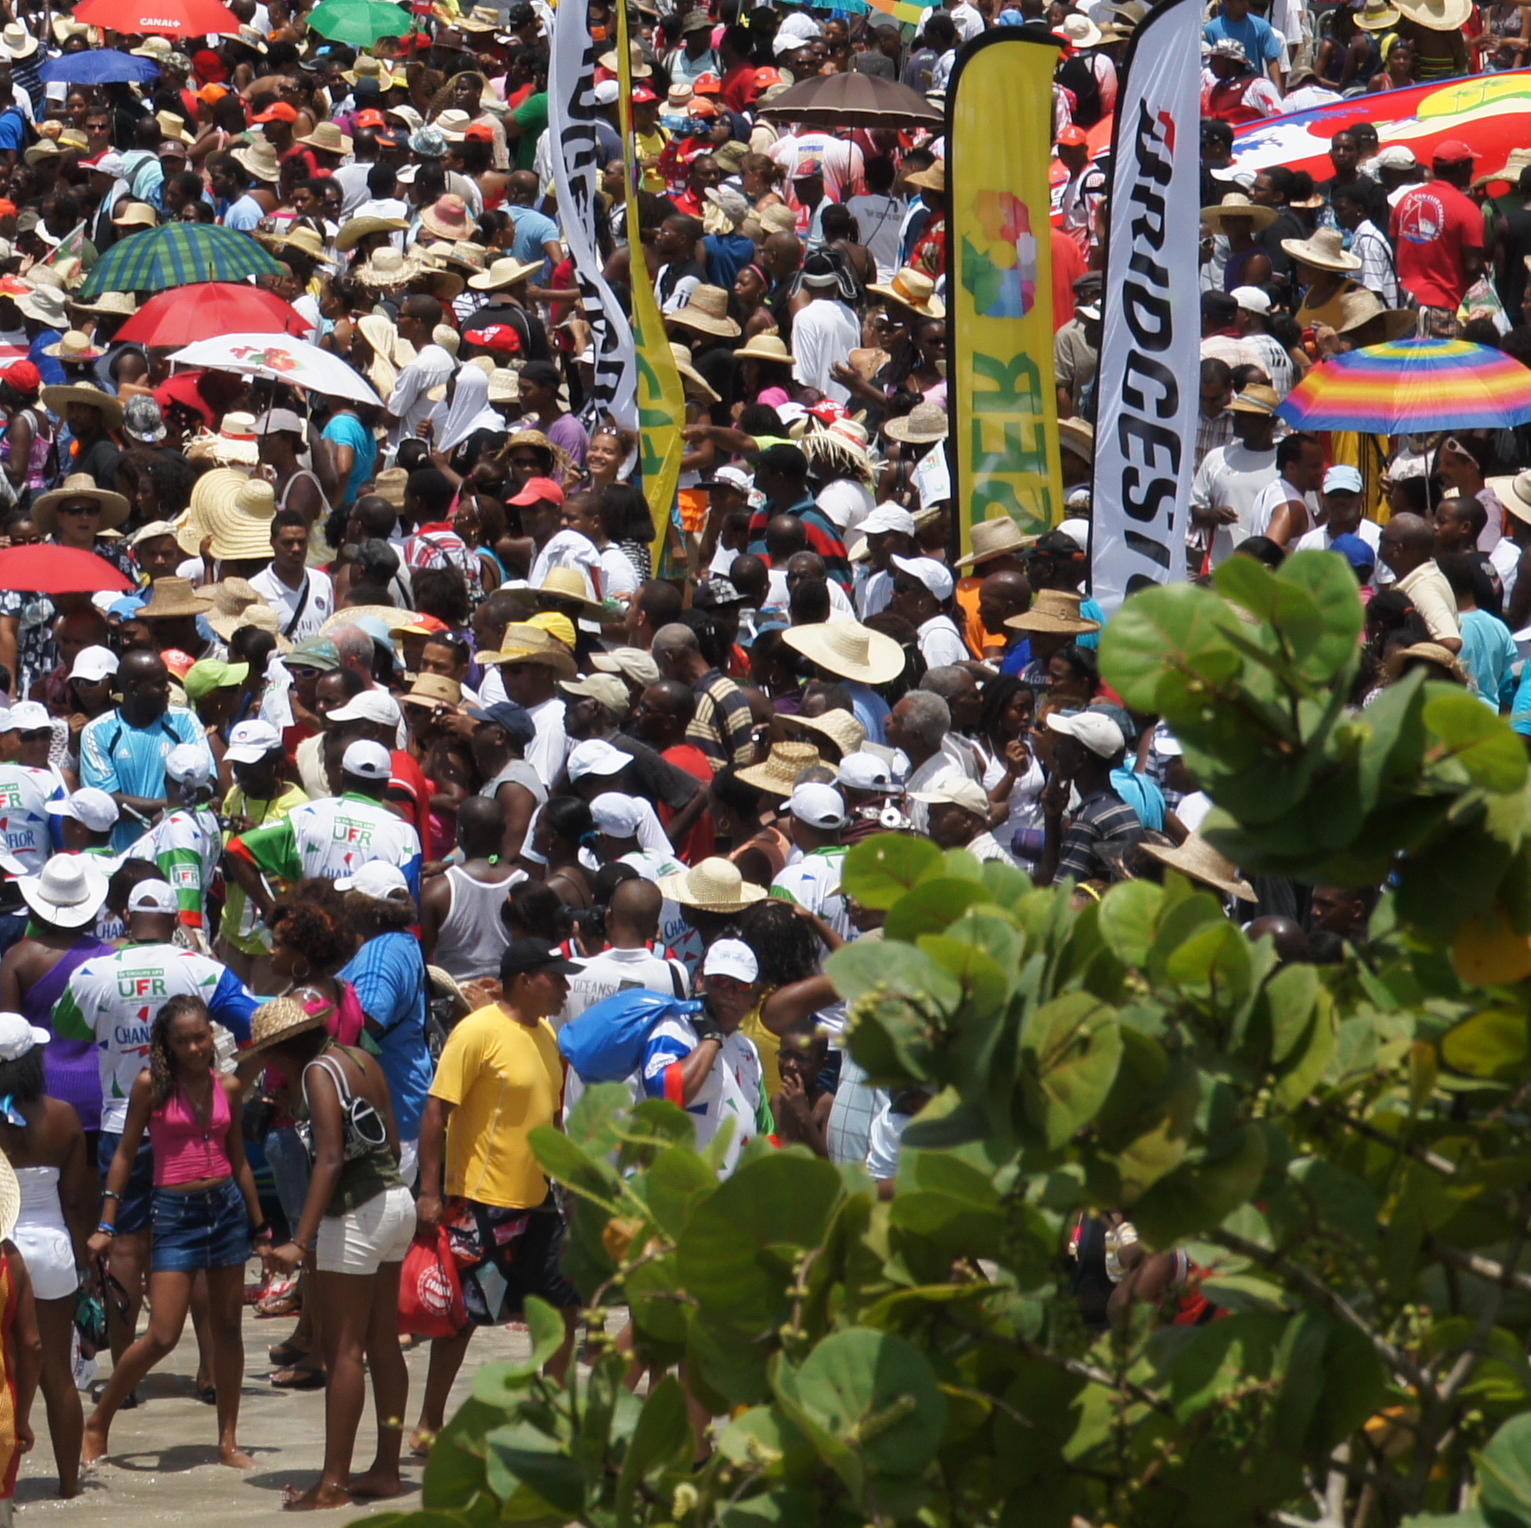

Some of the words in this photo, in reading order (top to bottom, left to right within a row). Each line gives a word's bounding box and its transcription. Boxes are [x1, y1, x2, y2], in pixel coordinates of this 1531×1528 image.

[139, 17, 182, 28] CANAL+
[1122, 96, 1181, 594] BRIDGEST
[332, 825, 373, 845] UFR
[171, 871, 201, 887] UFR
[117, 979, 168, 999] UFR
